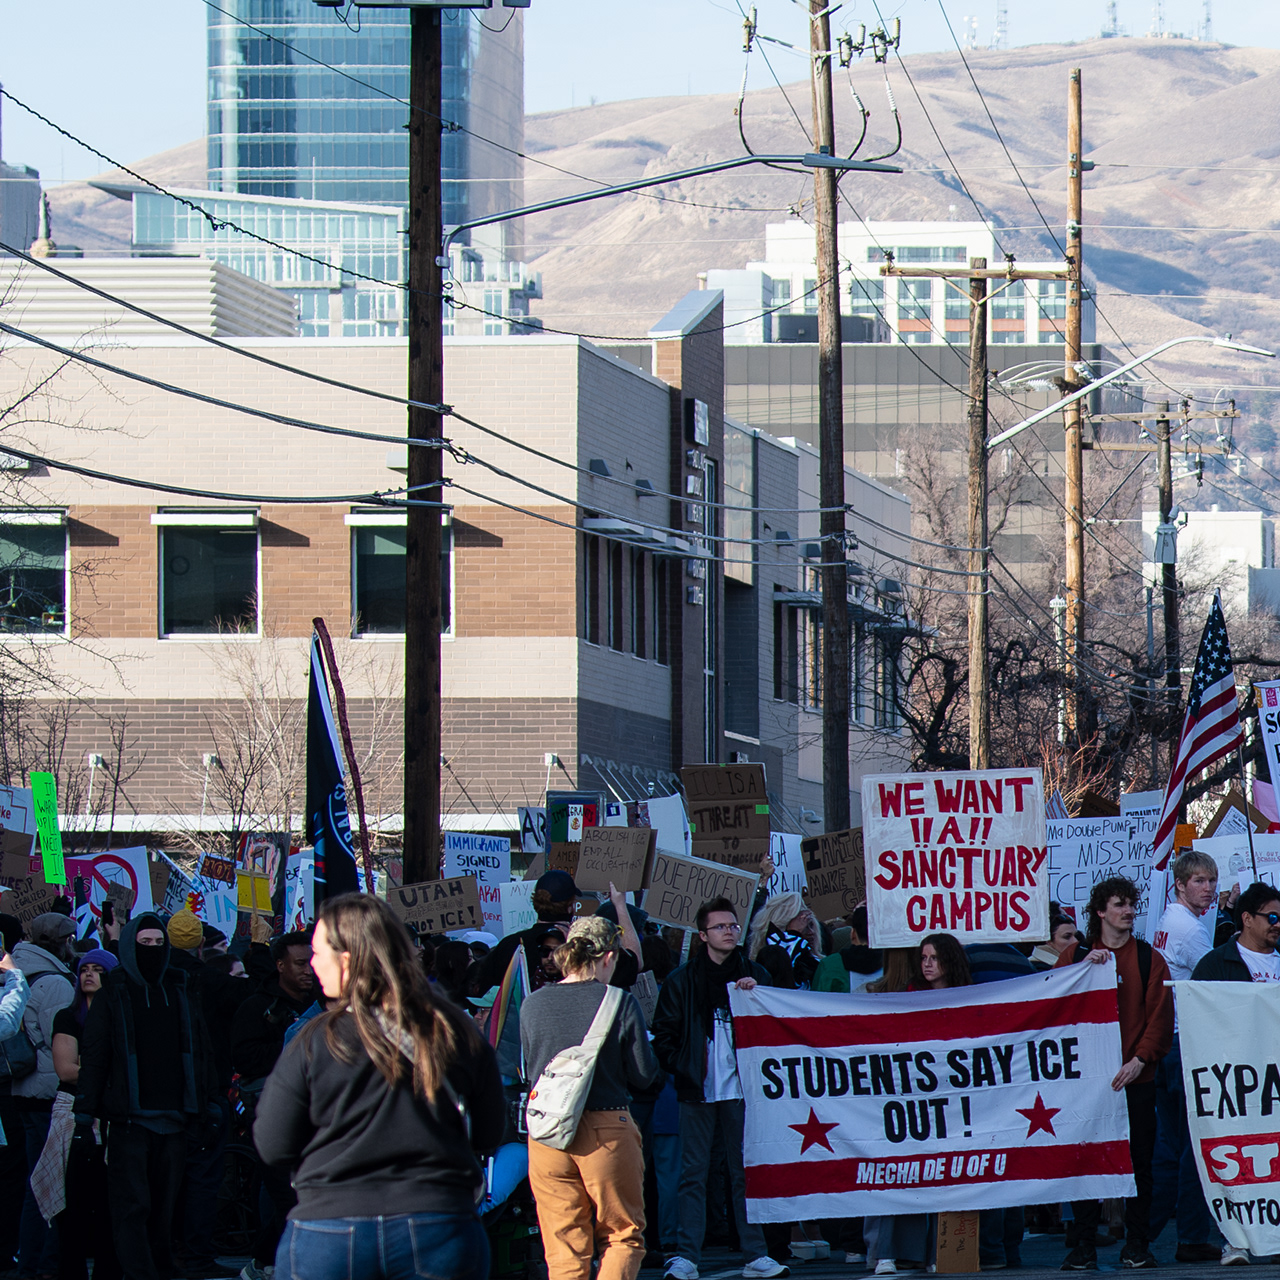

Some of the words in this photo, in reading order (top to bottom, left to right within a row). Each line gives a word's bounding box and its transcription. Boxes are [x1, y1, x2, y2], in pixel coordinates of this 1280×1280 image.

[726, 771, 744, 795] IS
[878, 782, 925, 817] WE
[934, 777, 1033, 814] WANT
[694, 806, 753, 832] THREAT
[447, 836, 511, 852] IMMIGRANTS
[585, 829, 629, 843] ABOLISH
[722, 837, 740, 849] TO
[457, 854, 500, 869] SIGNED
[462, 869, 488, 882] THE
[874, 845, 1047, 891] SANCTUARY
[399, 881, 464, 908] UTAH
[652, 857, 687, 892] DUE
[687, 866, 754, 910] PROCESS
[1048, 872, 1088, 905] ICE
[658, 891, 693, 921] FOR
[906, 891, 1030, 932] CAMPUS
[761, 1050, 939, 1100] STUDENTS
[946, 1044, 1014, 1089] SAY
[1026, 1037, 1082, 1082] ICE
[883, 1097, 950, 1144] OUT
[856, 1160, 921, 1185] MECHA
[923, 1157, 945, 1181] DE
[950, 1155, 966, 1178] U
[966, 1154, 990, 1176] OF
[993, 1152, 1007, 1176] U
